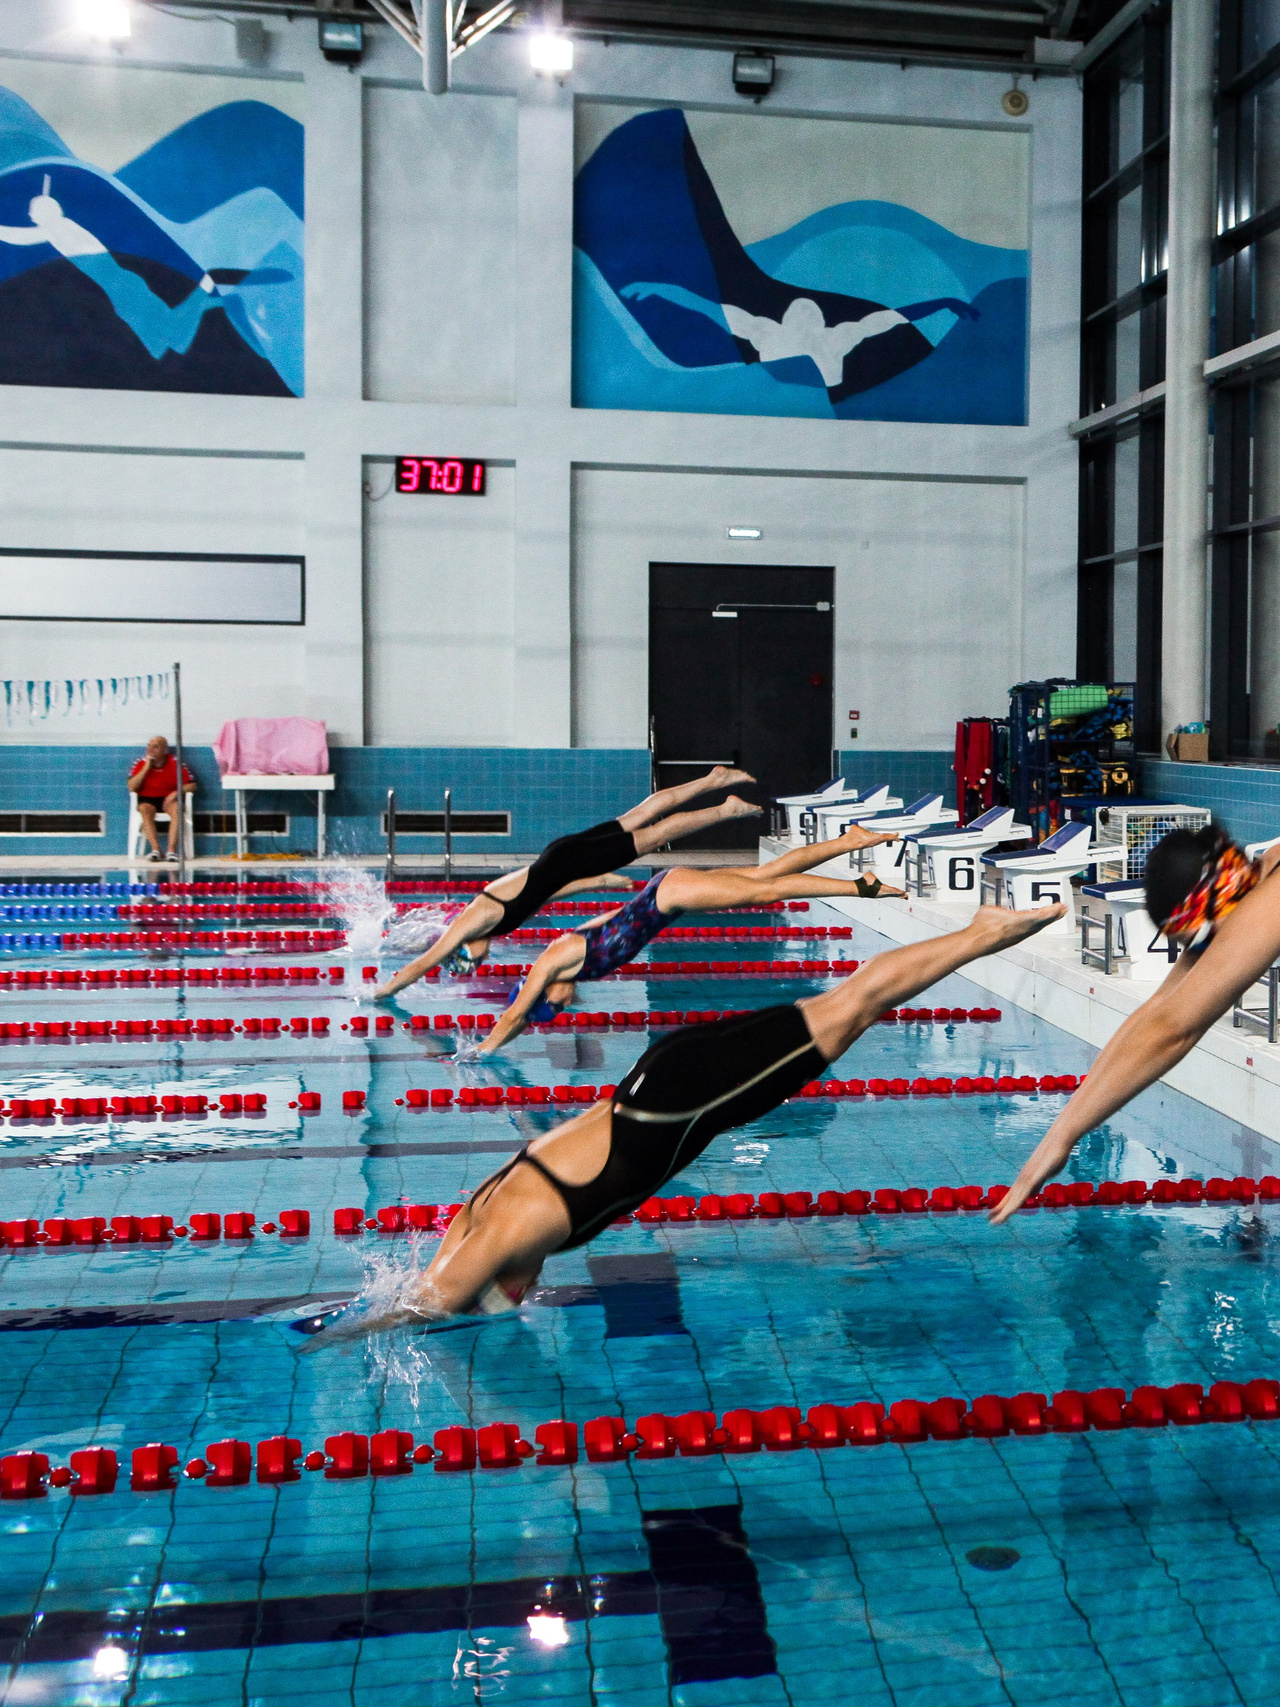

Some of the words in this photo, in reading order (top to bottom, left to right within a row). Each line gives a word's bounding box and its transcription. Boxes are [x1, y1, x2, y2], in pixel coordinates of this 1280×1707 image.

[400, 459, 482, 492] 37:01
[949, 857, 974, 890] 6
[1031, 882, 1061, 910] 5
[1147, 927, 1182, 963] 4
